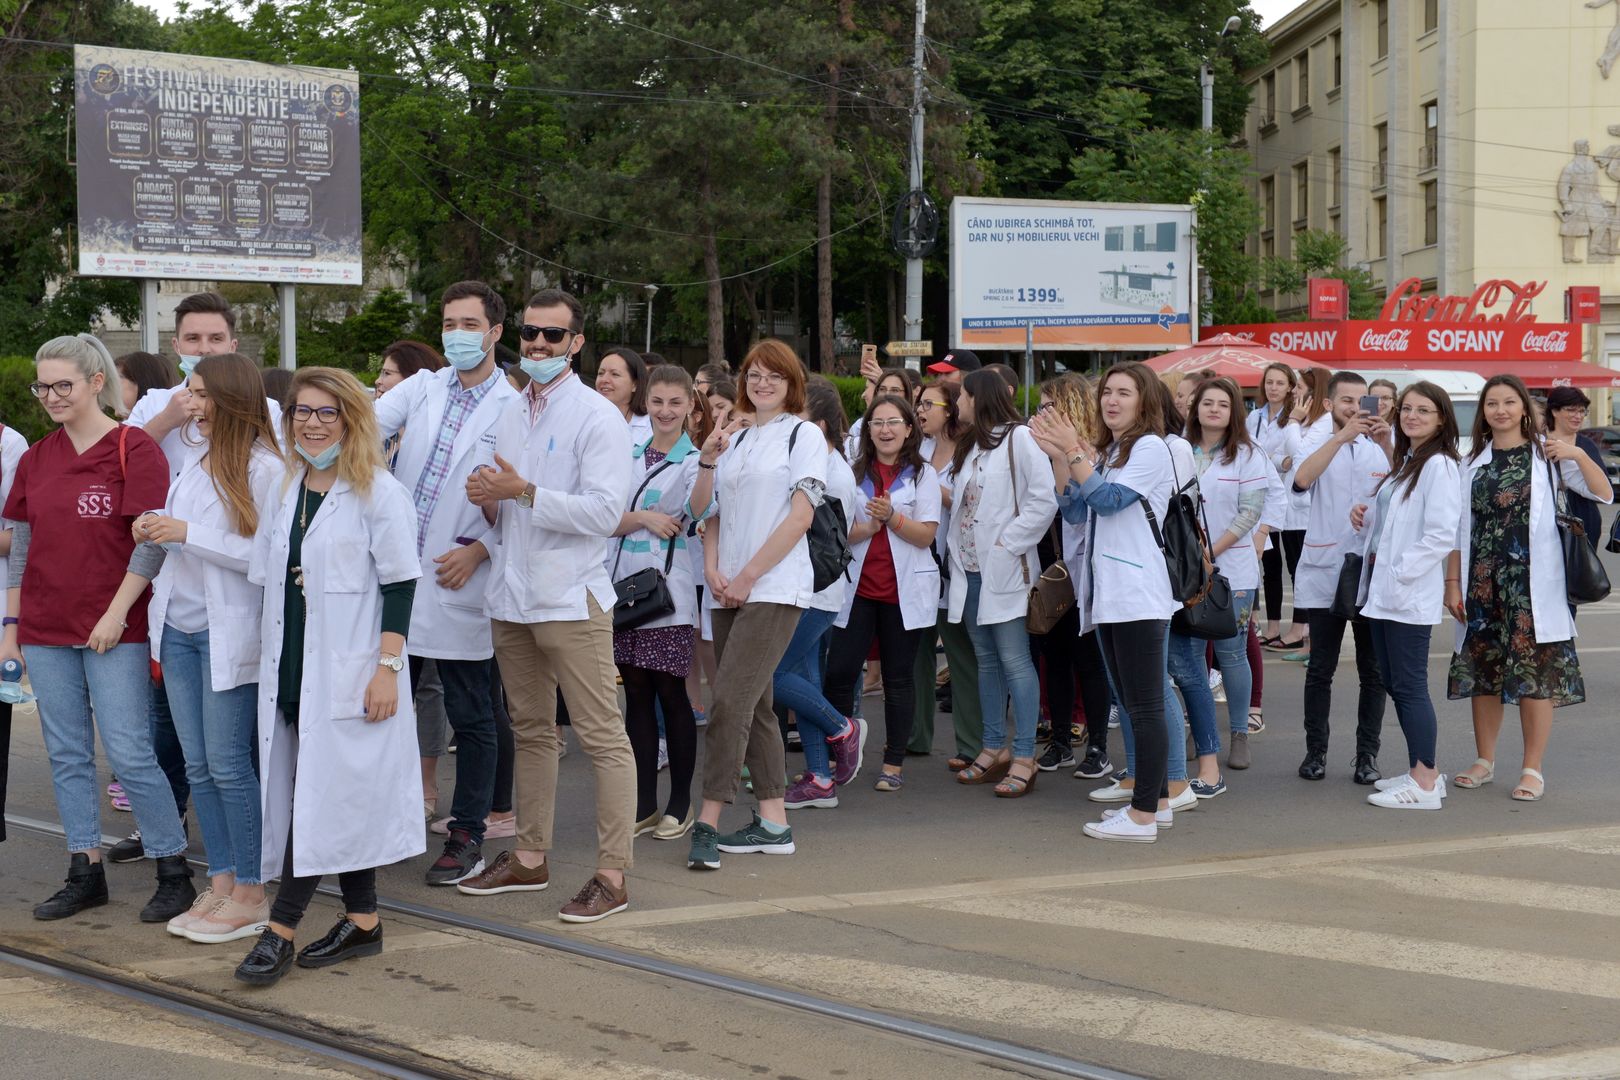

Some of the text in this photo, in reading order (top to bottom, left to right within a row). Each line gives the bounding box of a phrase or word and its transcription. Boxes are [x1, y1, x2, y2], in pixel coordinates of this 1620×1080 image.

[123, 65, 320, 102] FESTIVALUL OPERELOR
[158, 88, 289, 119] INDEPENDENTE
[161, 128, 194, 140] FIGARO
[251, 125, 287, 137] MOTANUL
[299, 128, 328, 140] ICOANE
[212, 134, 235, 145] NUME
[136, 182, 174, 194] O NOAPTE
[194, 185, 210, 194] DON
[185, 194, 220, 205] GIOVANNI
[968, 217, 1095, 229] CÂND IUBIREA SCHIMBĂ TOT,
[969, 232, 1100, 243] DAR NU ȘI MOBILIERUL VECHI
[1018, 288, 1057, 302] 1399
[1269, 331, 1337, 352] SOFANY
[1360, 328, 1569, 352] Coca-Cola SOFANY Coca-Cola
[78, 495, 112, 515] SSS
